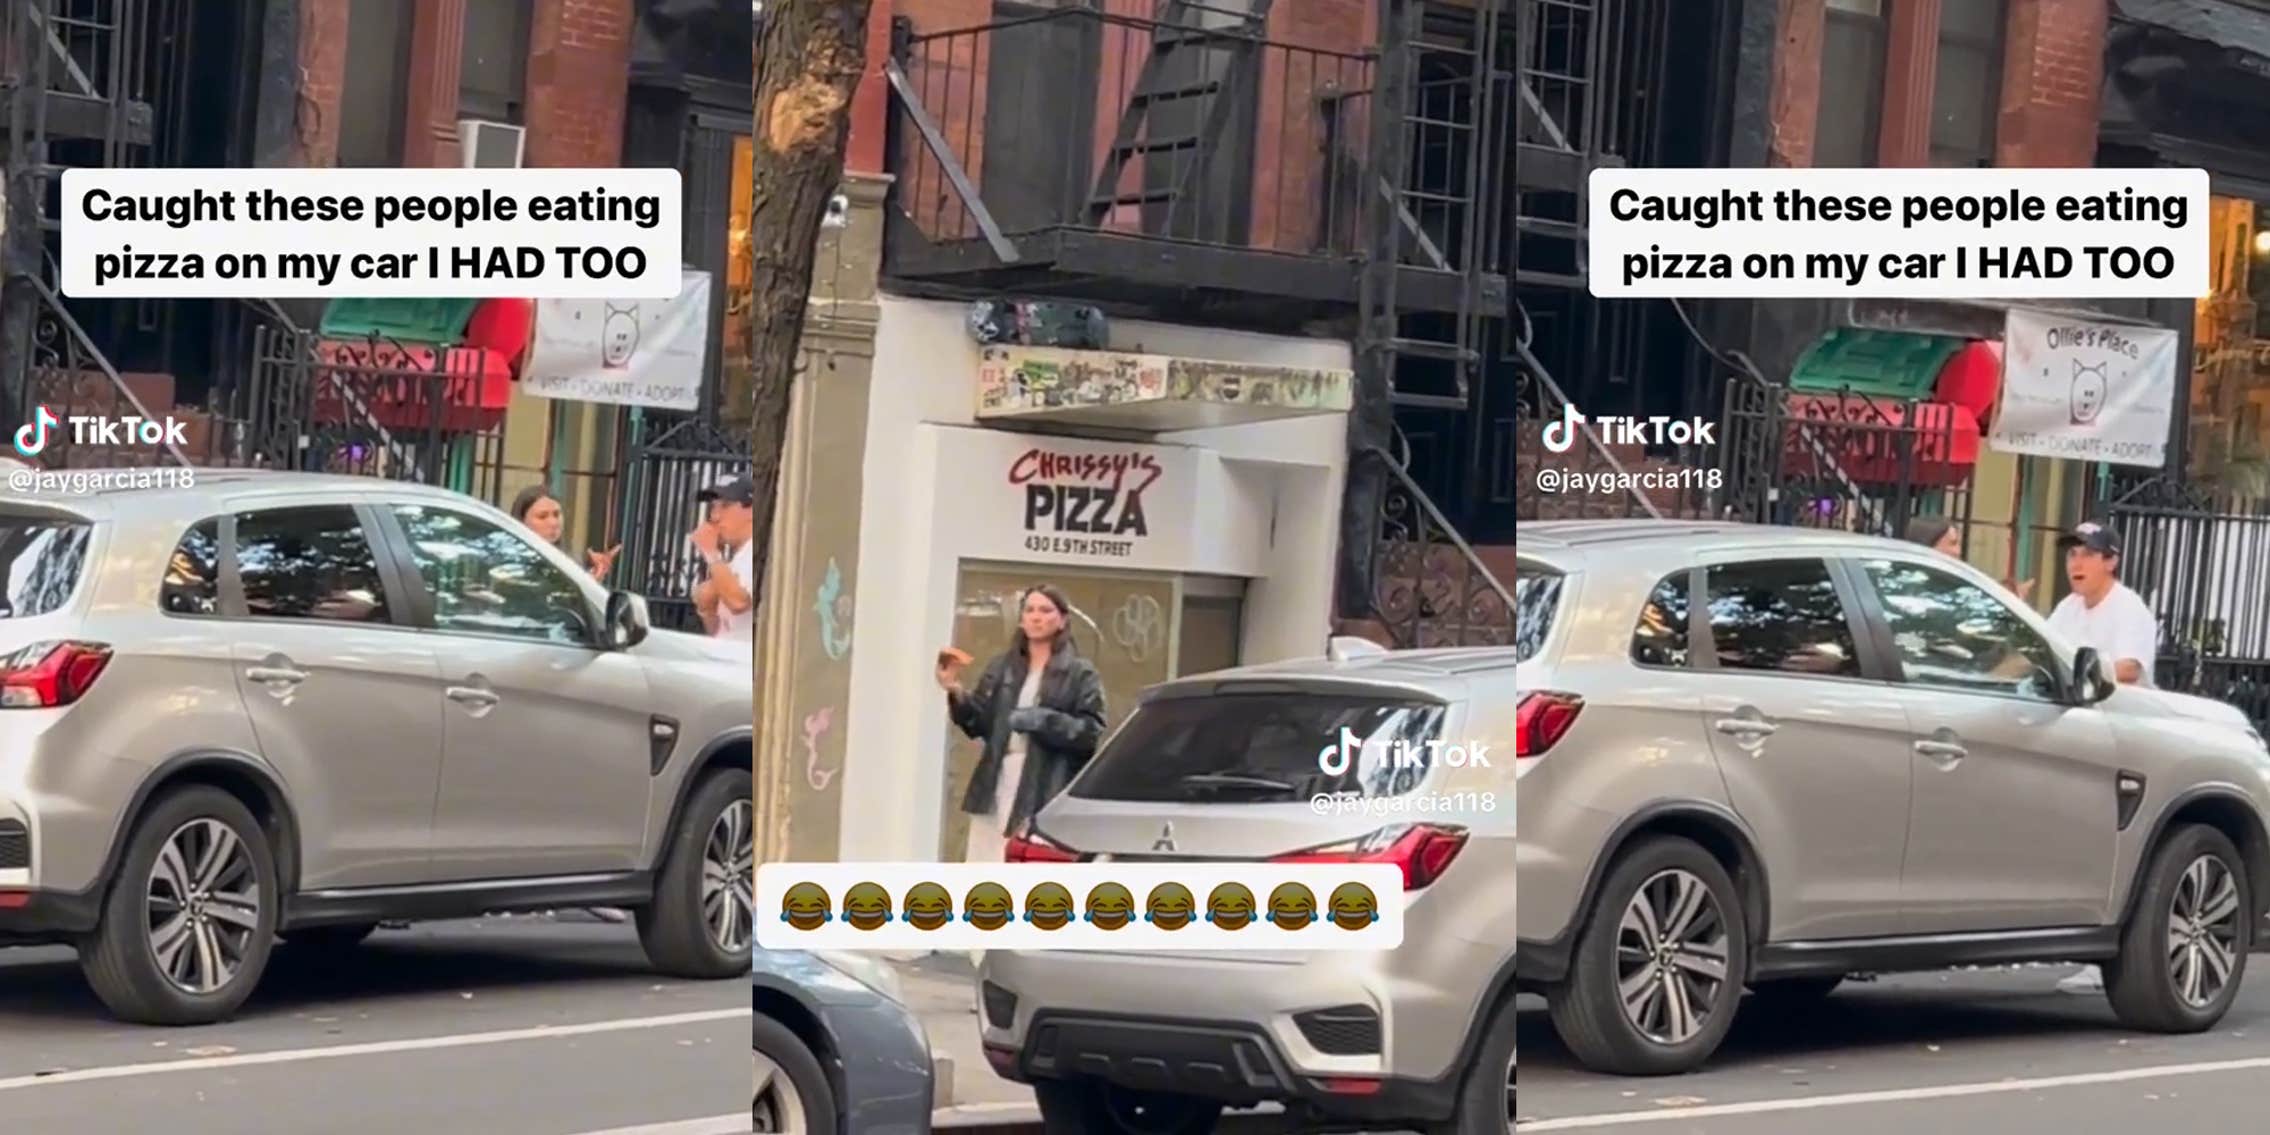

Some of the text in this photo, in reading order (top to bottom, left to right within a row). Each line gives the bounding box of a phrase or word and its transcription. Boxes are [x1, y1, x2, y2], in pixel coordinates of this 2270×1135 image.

[2047, 327, 2140, 360] Ollie's Place
[580, 379, 634, 397] DONATE
[645, 384, 684, 401] ADOPT
[2048, 435, 2101, 453] DONATE
[1009, 449, 1163, 494] CHRISSY'S
[1024, 483, 1148, 537] PIZZA
[1024, 535, 1050, 552] 430
[1090, 540, 1133, 556] STREET
